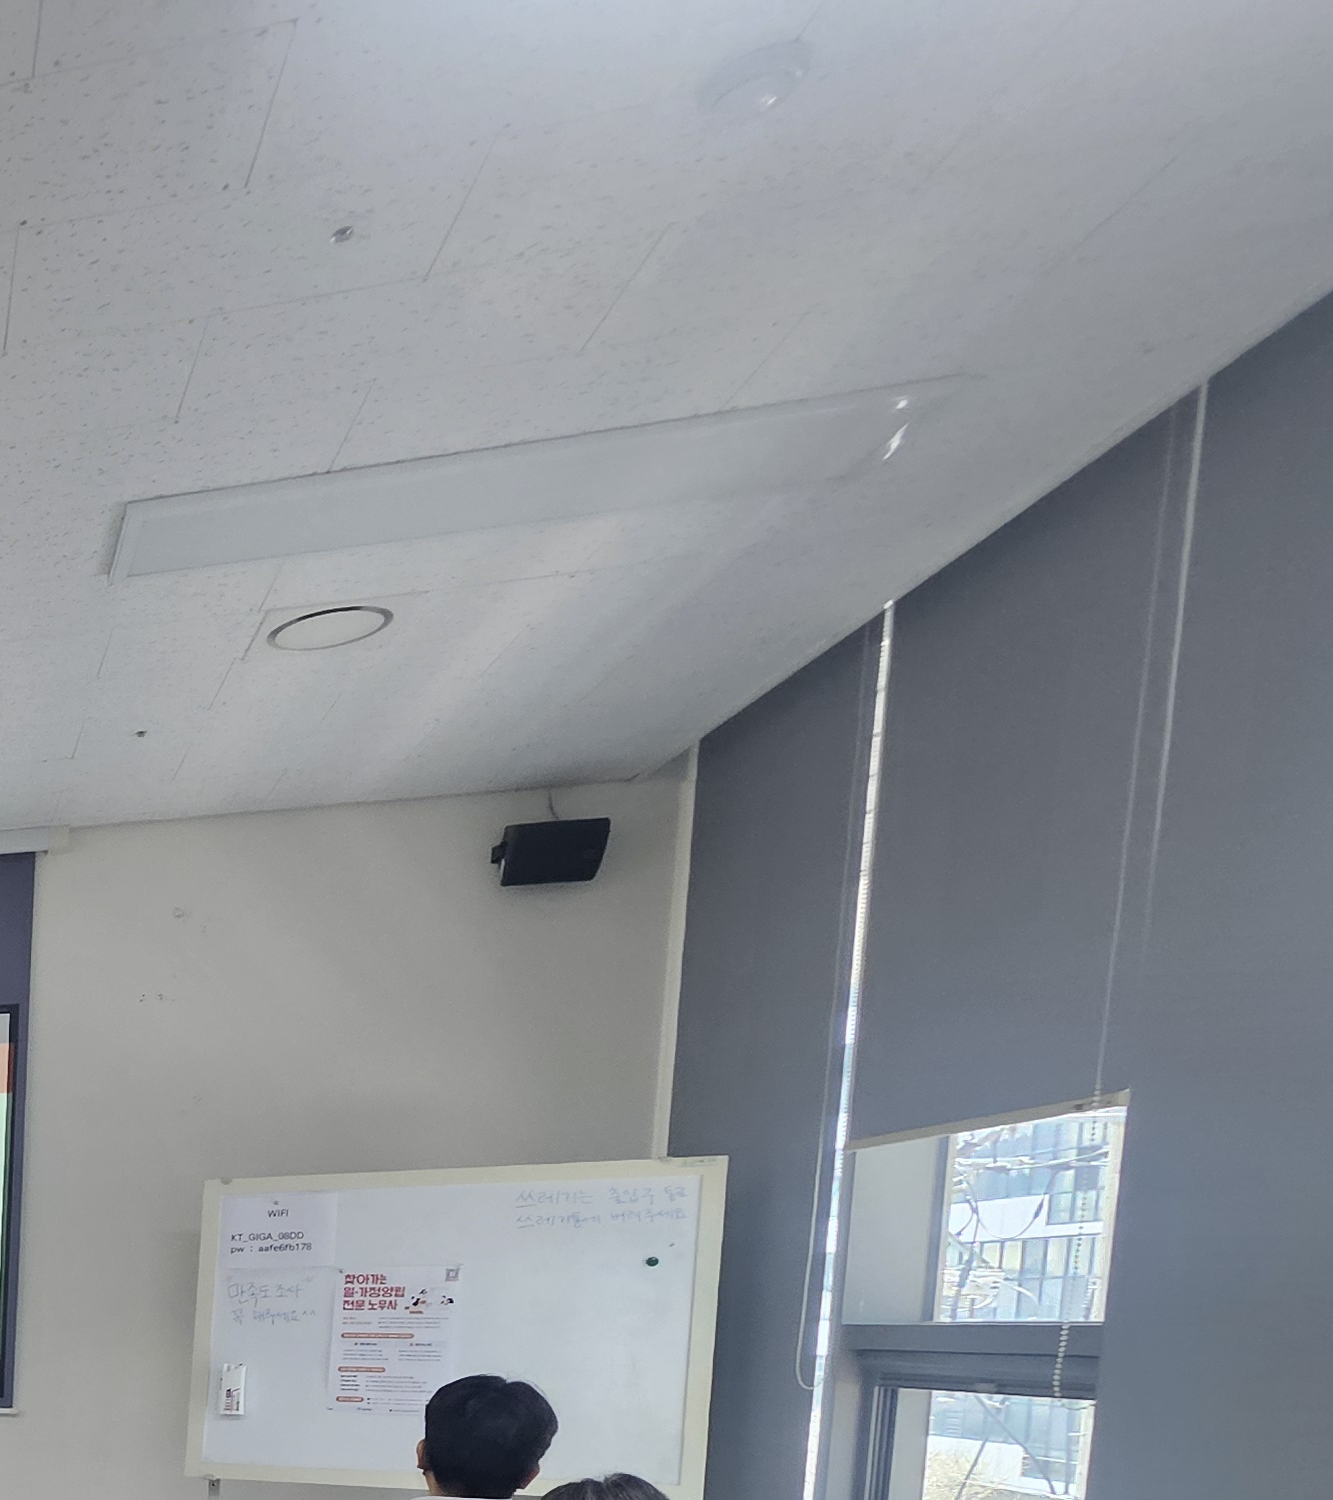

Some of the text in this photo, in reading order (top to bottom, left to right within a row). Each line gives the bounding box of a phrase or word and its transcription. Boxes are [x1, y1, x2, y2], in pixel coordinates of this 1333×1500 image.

[268, 1209, 289, 1218] WIFI
[230, 1246, 244, 1254] pw
[344, 1273, 387, 1285] 찾아가는
[227, 1281, 303, 1308] 만족도 조사
[342, 1299, 398, 1311] 전문 노무사
